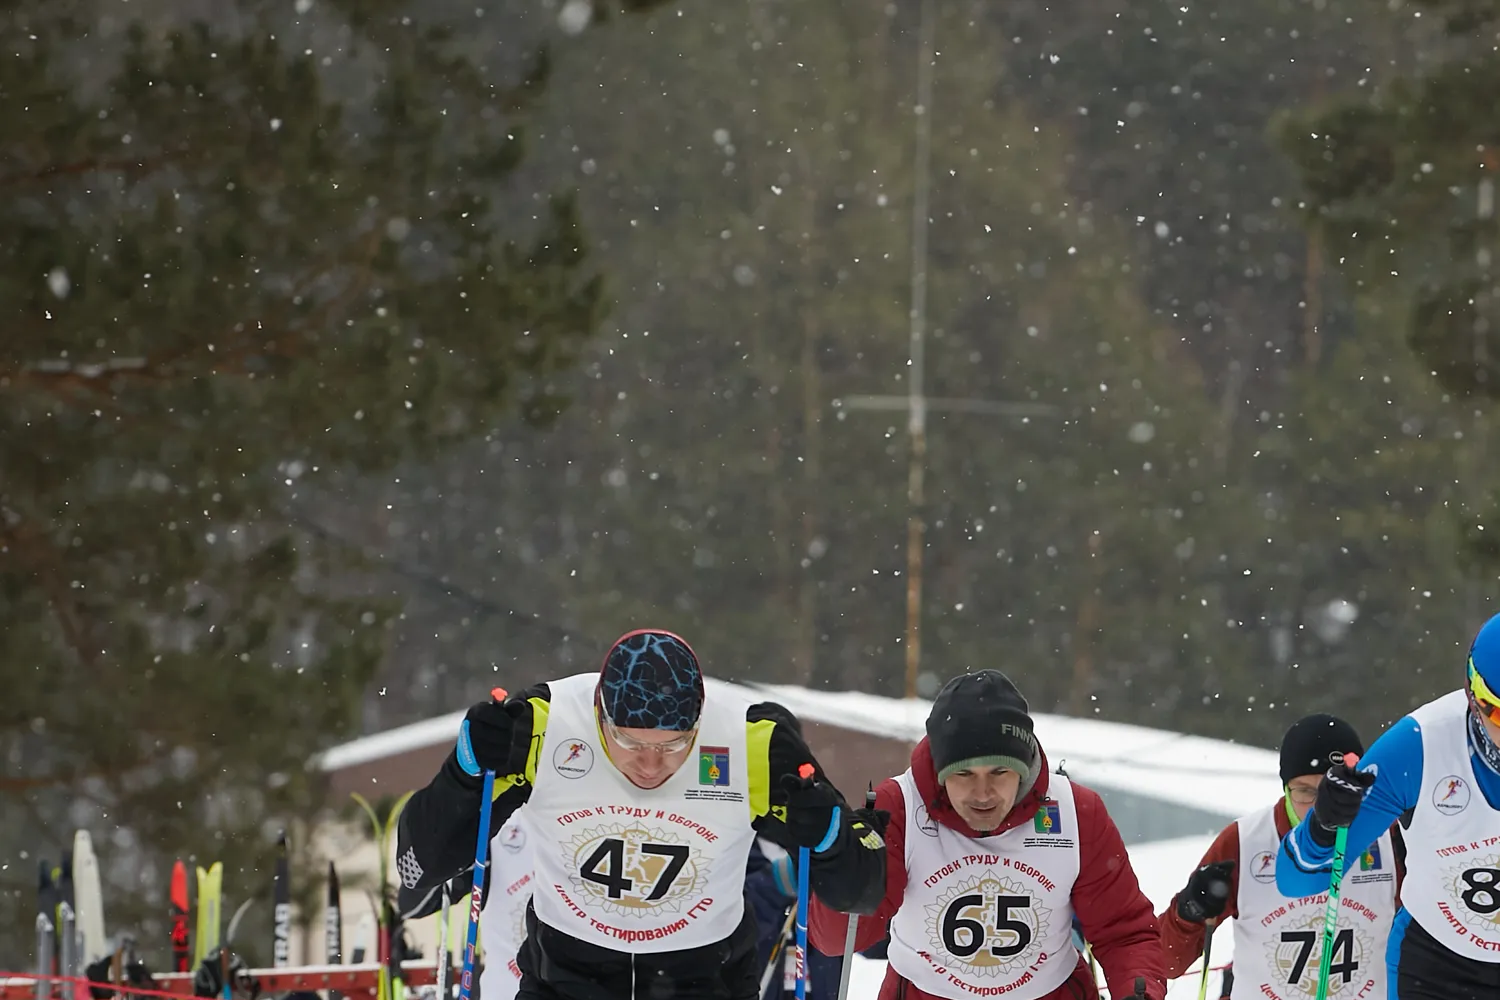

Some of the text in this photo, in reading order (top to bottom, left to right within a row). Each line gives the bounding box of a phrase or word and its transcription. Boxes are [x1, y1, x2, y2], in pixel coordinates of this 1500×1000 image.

[557, 805, 719, 843] ГОТОВ К ТРУДУ И ОБОРОНЕ
[580, 838, 689, 901] 47
[1436, 844, 1467, 859] ГОТОВ
[923, 864, 954, 889] ГОТОВ
[962, 855, 1000, 867] ТРУДУ
[1003, 858, 1011, 867] И
[1014, 861, 1056, 892] ОБОРОНЕ
[470, 885, 483, 922] KV+
[554, 883, 714, 943] Центр тестирования ГТО
[1261, 907, 1287, 928] ГОТОВ
[1298, 895, 1330, 906] ТРУДУ
[1342, 897, 1378, 922] ОБОРОНЕ
[1437, 901, 1468, 936] Центр
[943, 895, 1031, 957] 65
[507, 958, 522, 979] Цен
[794, 944, 804, 978] KV+
[1281, 929, 1359, 985] 74
[948, 970, 1033, 997] тестирования
[1361, 979, 1376, 999] ГТО
